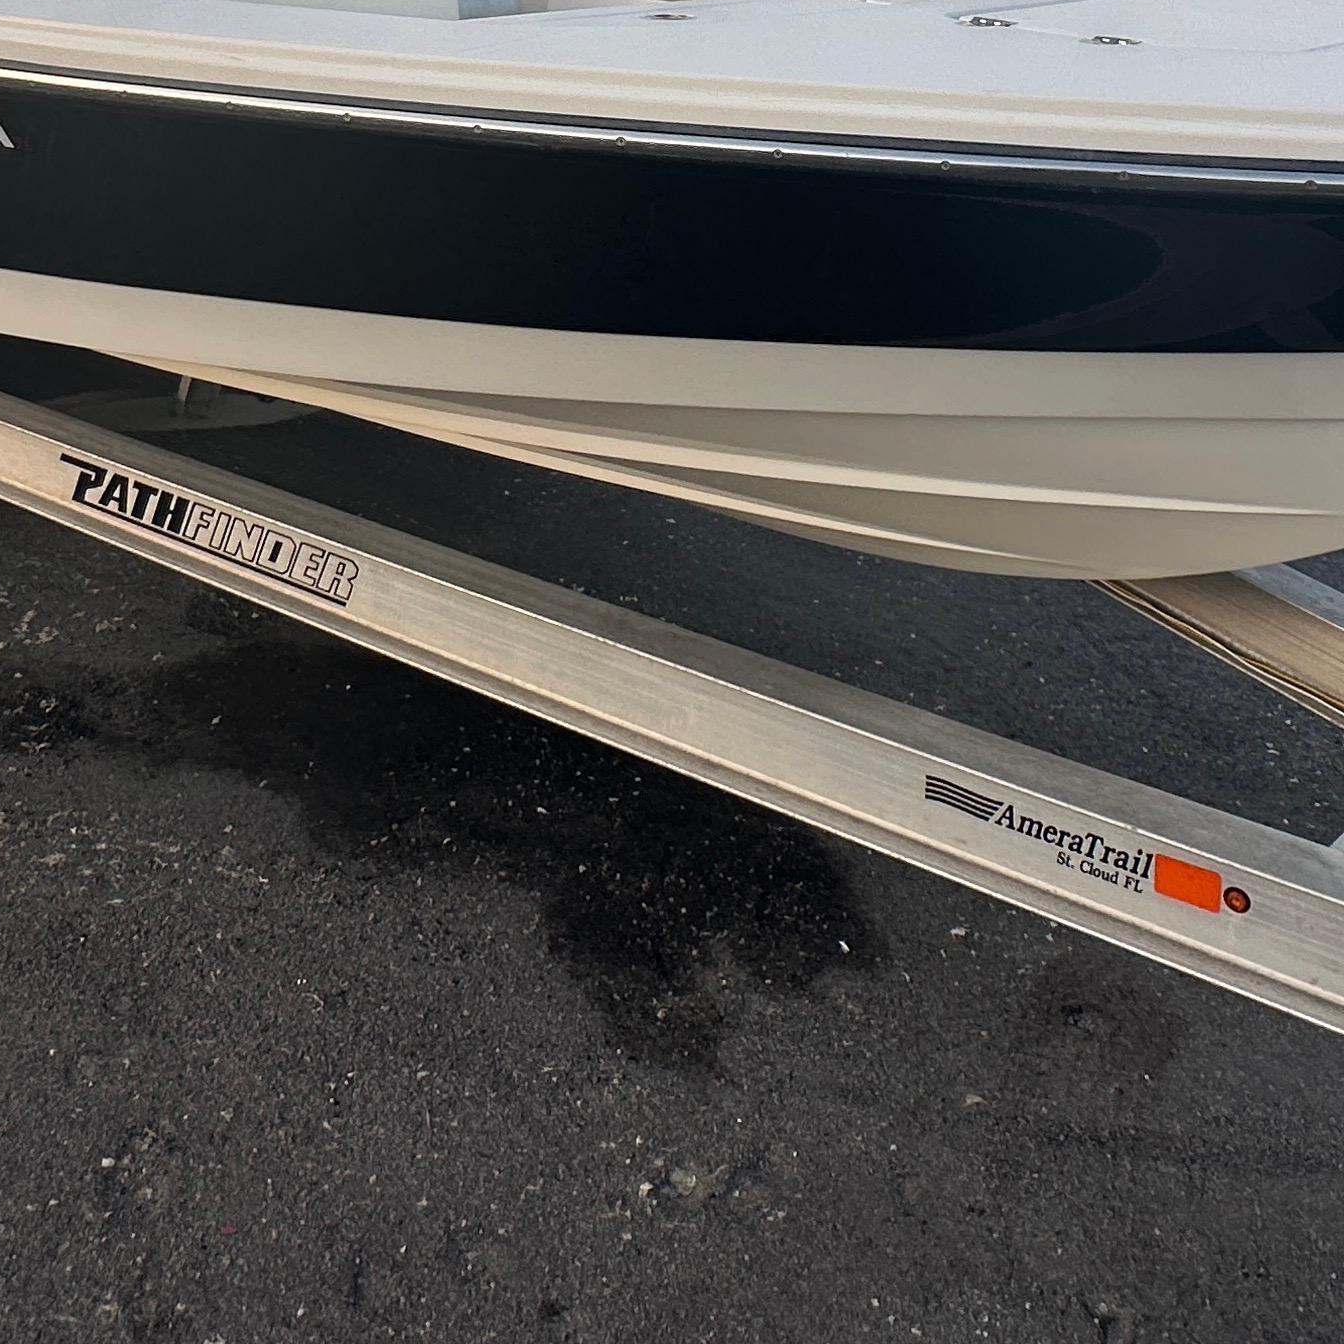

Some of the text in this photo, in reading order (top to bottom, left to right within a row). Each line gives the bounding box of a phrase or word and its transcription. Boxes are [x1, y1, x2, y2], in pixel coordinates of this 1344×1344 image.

[59, 453, 360, 604] PATHFINDER
[994, 804, 1155, 879] AmeraTrail
[1056, 851, 1144, 894] St. Cloud FL
